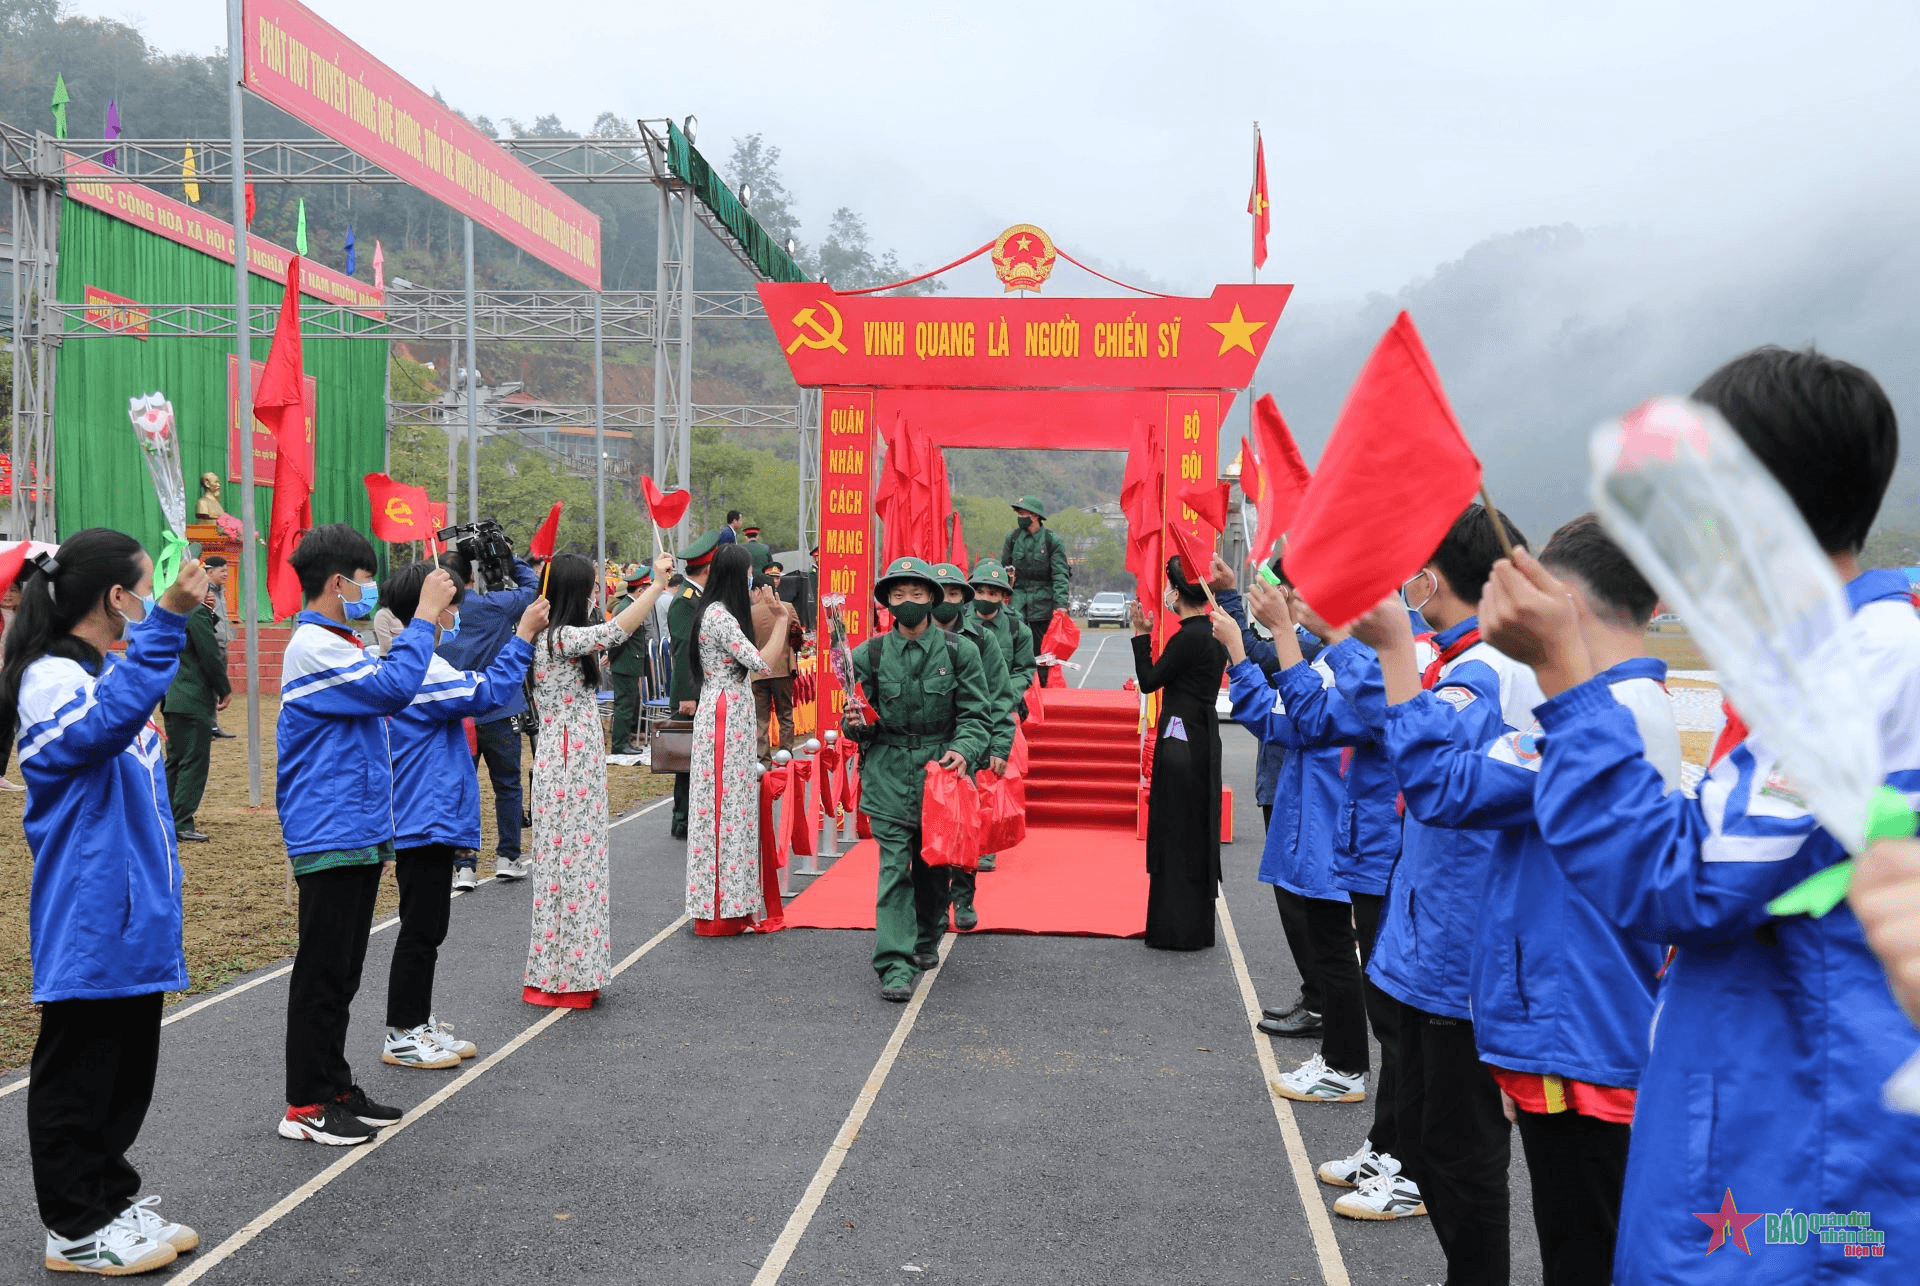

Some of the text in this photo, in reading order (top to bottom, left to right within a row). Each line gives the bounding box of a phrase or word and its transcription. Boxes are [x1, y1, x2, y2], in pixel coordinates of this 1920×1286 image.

[259, 15, 286, 78] PHÁT
[289, 35, 308, 92] HUY
[377, 94, 394, 145] QUÊ
[117, 190, 155, 222] CỘNG
[186, 219, 203, 243] XÃ
[206, 228, 224, 252] HỘI
[864, 311, 1182, 361] VINH QUANG LÀ NGƯỜI CHIẾN SỸ
[830, 405, 865, 436] QUÂN
[1183, 409, 1201, 444] BỘ
[829, 445, 864, 475] NHÂN
[829, 484, 863, 515] CÁCH
[826, 529, 864, 558] MẠNG
[830, 565, 857, 596] MỘT
